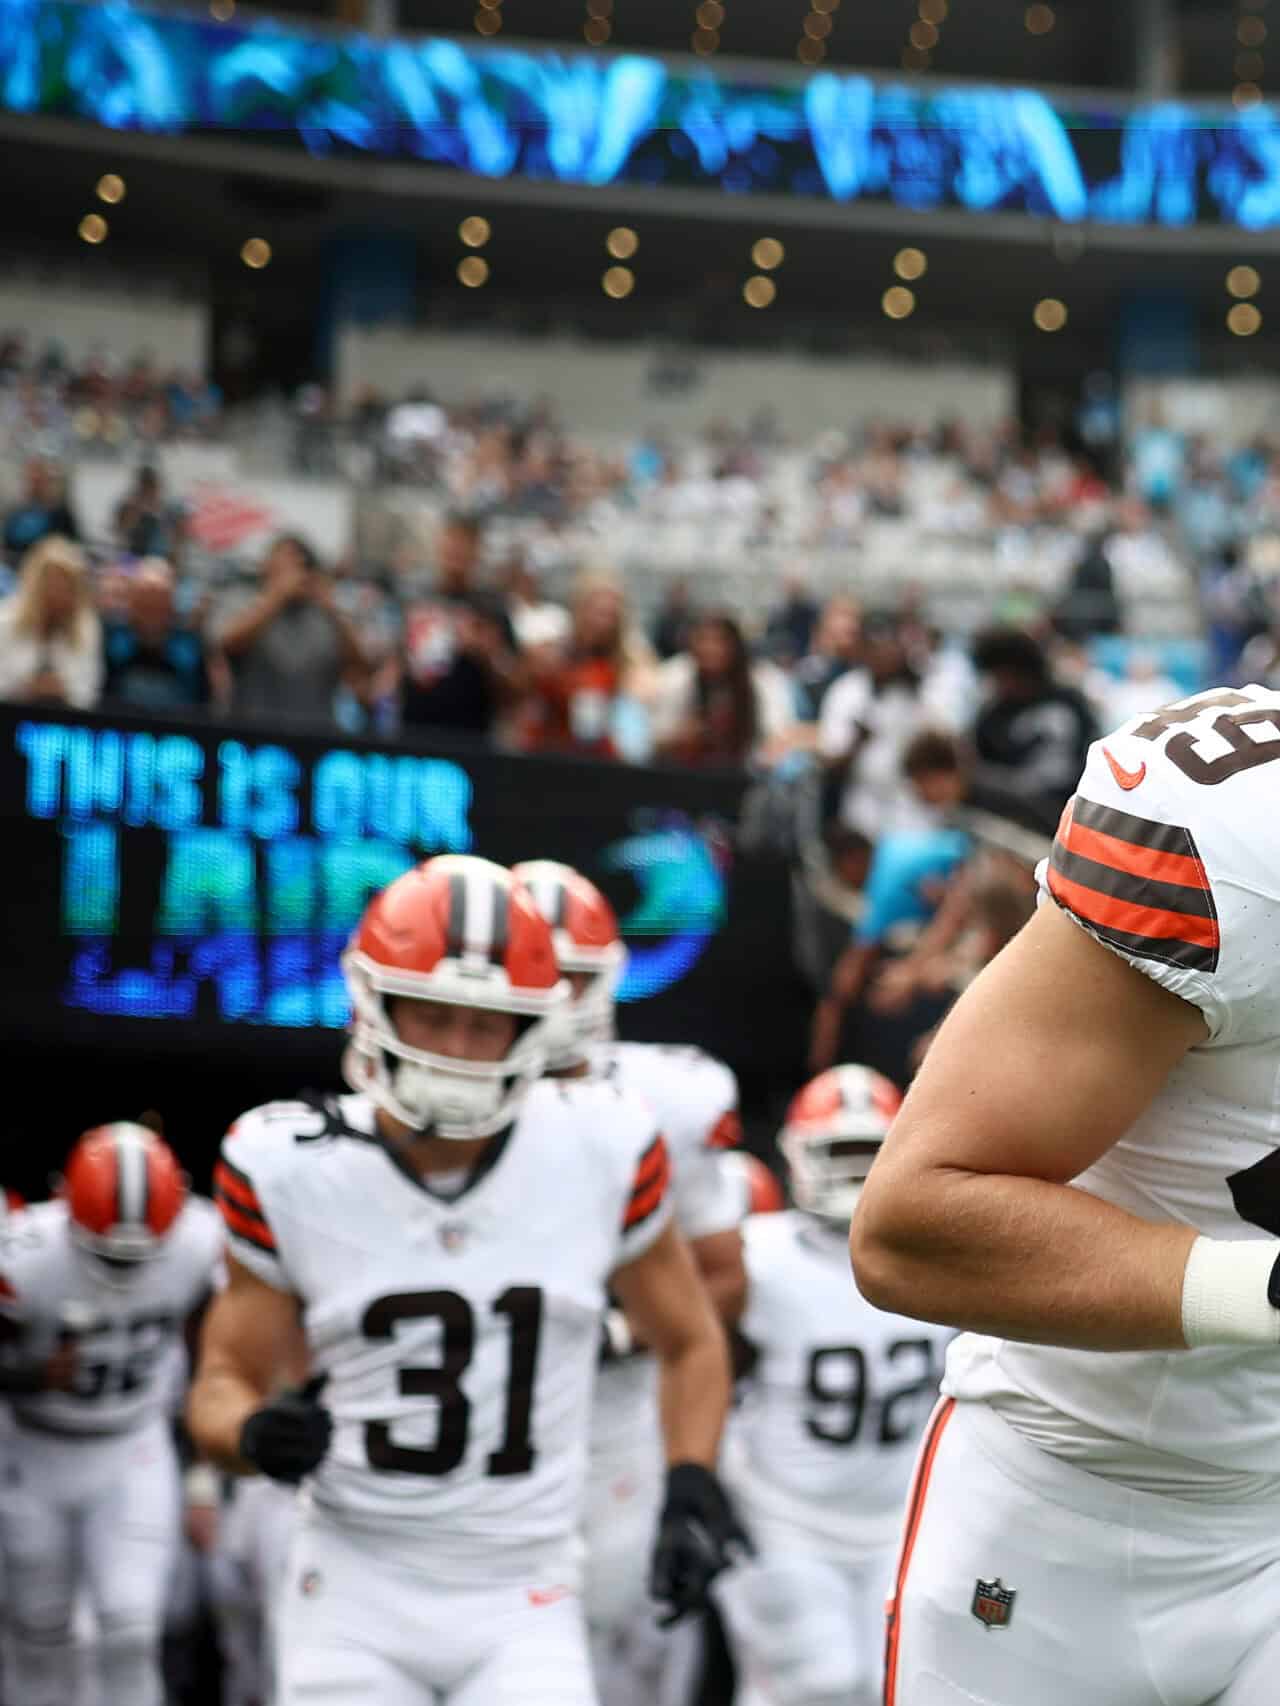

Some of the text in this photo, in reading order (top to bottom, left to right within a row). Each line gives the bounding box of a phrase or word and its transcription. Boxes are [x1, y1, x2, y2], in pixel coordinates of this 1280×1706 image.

[15, 720, 473, 854] THIS IS OUR
[361, 1286, 544, 1477] 31
[805, 1338, 934, 1445] 92
